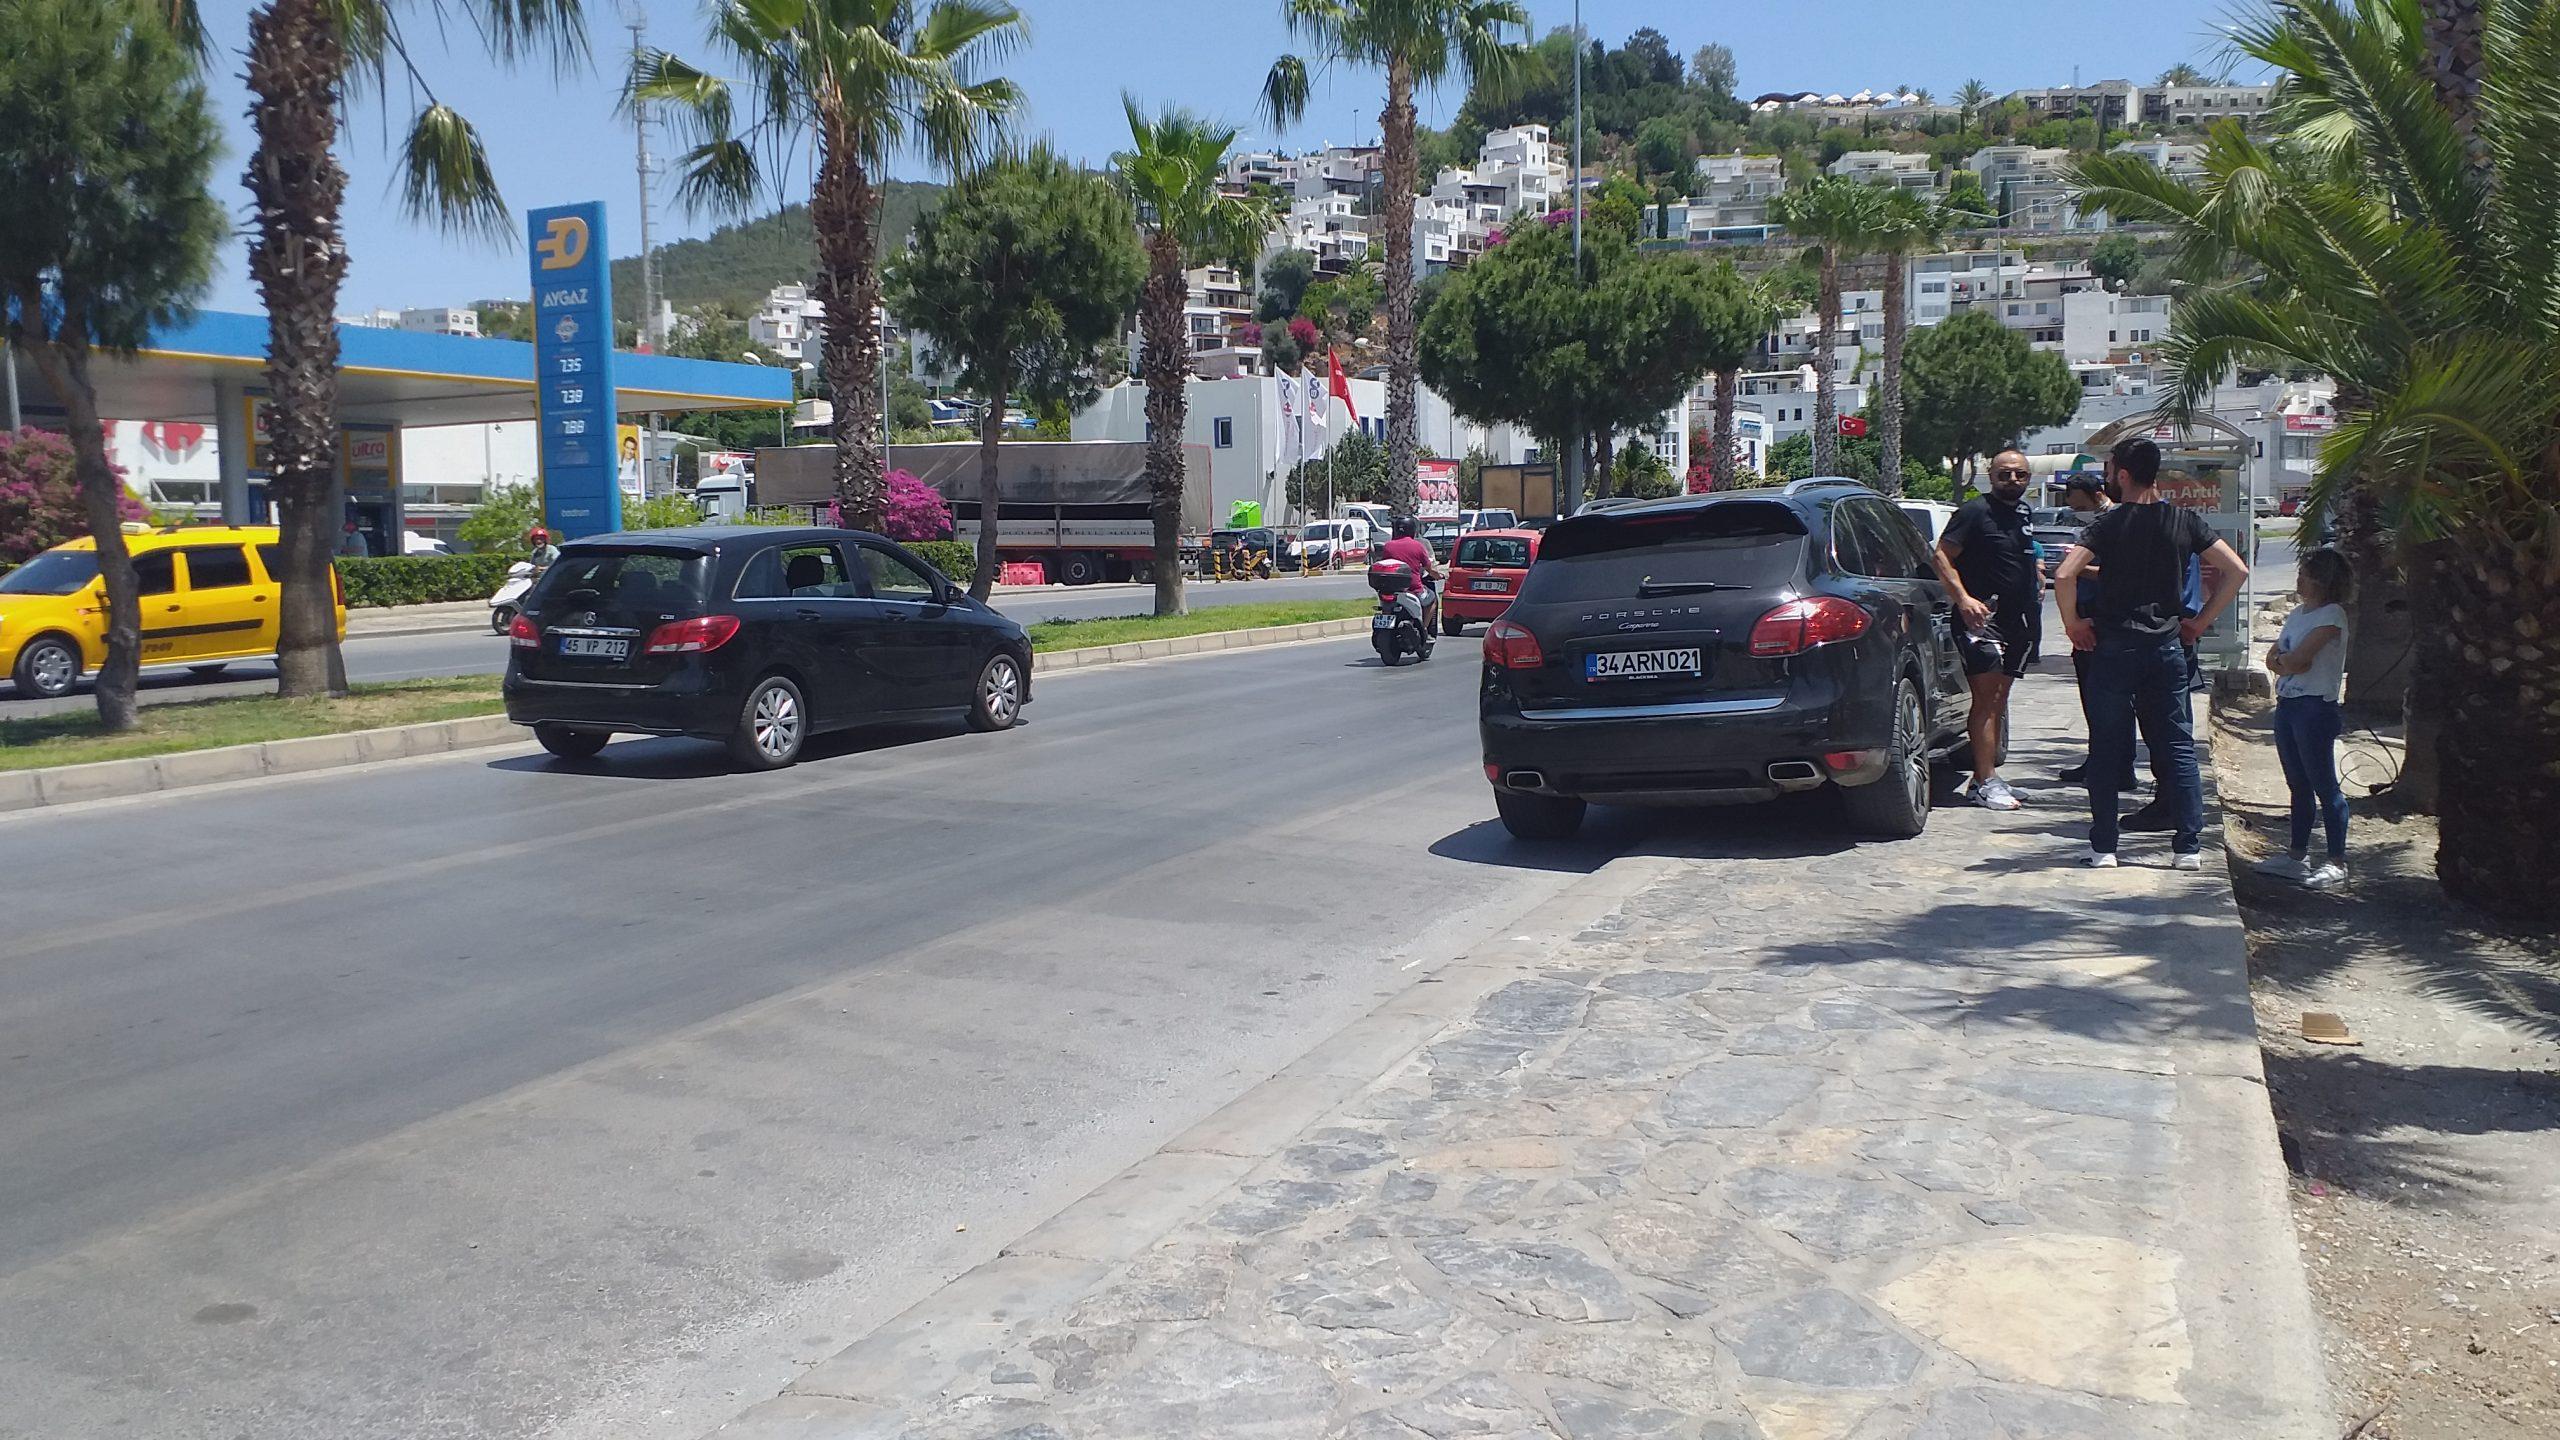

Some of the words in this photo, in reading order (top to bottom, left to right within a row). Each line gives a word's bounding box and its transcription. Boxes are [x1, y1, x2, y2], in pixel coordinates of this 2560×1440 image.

[543, 288, 588, 307] AYGAZ
[352, 441, 385, 458] ultra
[1582, 607, 1700, 621] PORSCHE
[566, 640, 579, 652] 45
[587, 640, 600, 653] VP
[605, 641, 626, 655] 212
[1597, 655, 1619, 674] 34
[1621, 652, 1664, 673] ARN
[1667, 650, 1699, 670] 021
